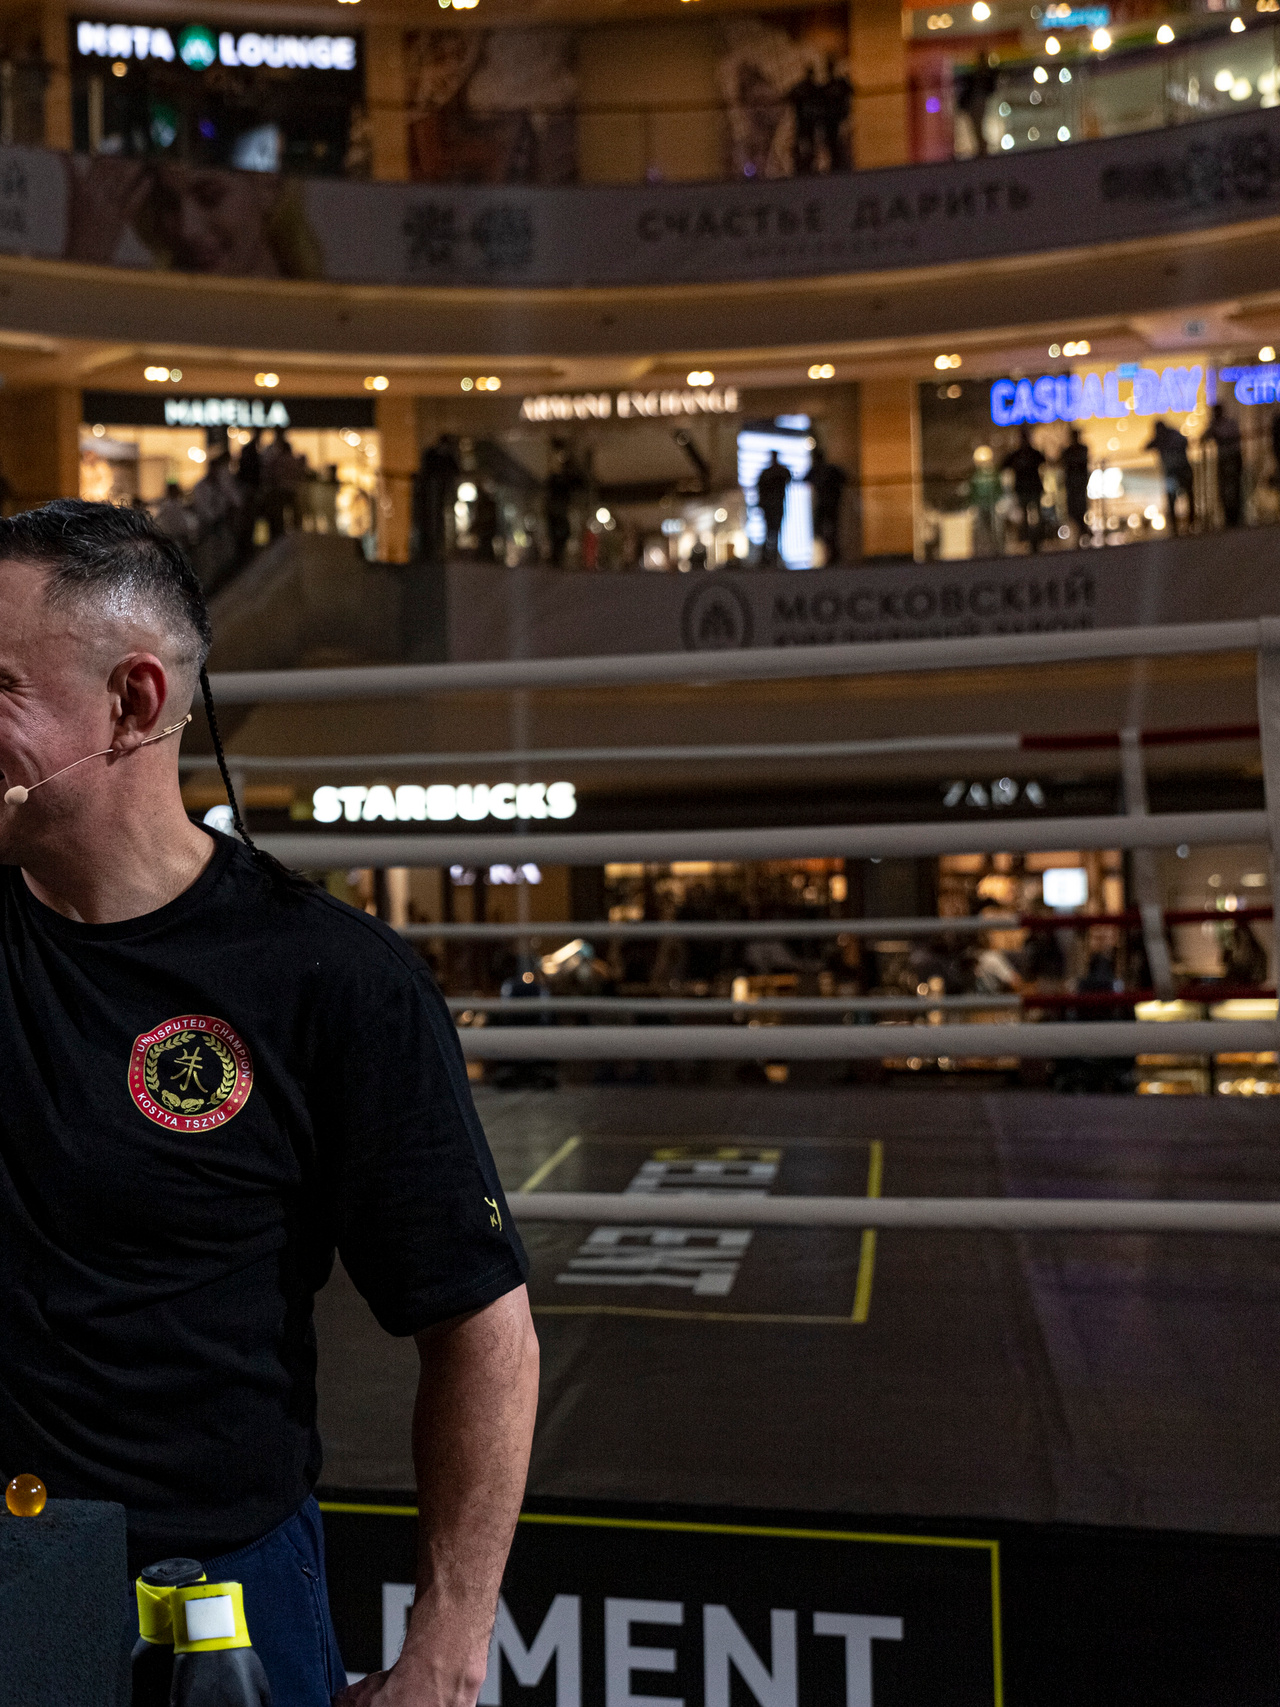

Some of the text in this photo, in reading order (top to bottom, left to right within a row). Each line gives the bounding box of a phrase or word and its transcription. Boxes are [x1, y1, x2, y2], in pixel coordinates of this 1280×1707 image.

[219, 31, 357, 70] LOUNGE
[637, 178, 1032, 242] СЧАСТЬЕ ДАРИТЬ
[990, 364, 1203, 427] CASUAL DAY
[771, 568, 1097, 625] МОСКОВСКИЙ
[313, 781, 577, 823] STARBUCKS
[136, 1018, 252, 1079] UNDISPUTED CHAMPION
[136, 1092, 226, 1129] KOSTYA TSZYU
[345, 1582, 904, 1707] MENT
